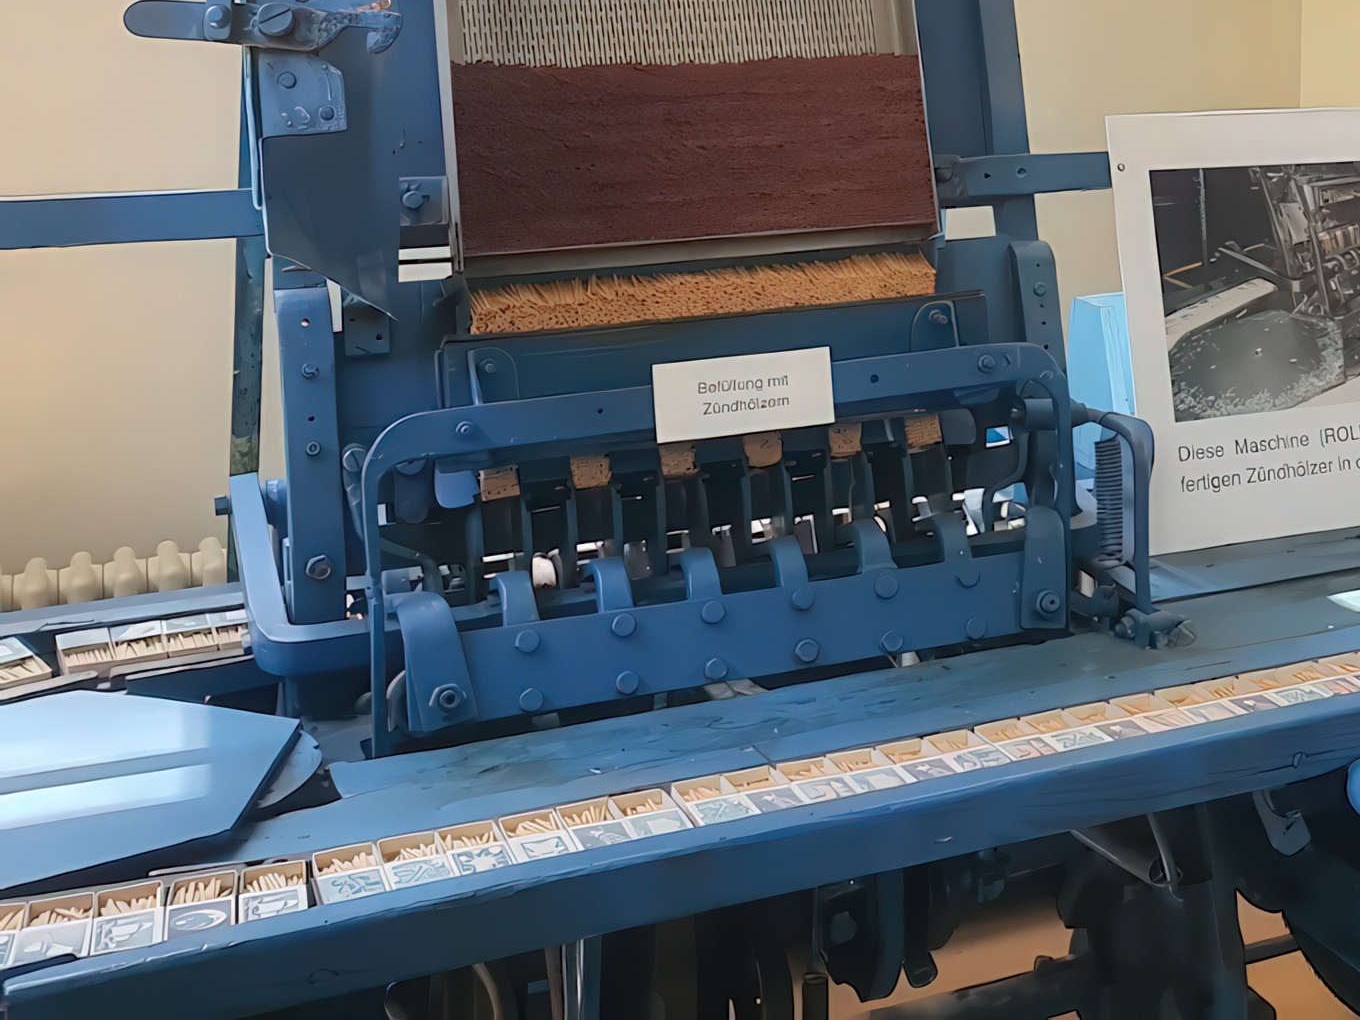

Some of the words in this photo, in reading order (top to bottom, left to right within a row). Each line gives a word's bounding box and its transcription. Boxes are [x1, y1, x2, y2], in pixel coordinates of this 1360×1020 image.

[767, 375, 789, 388] mit
[702, 396, 790, 416] Zündhölzern
[1178, 444, 1225, 462] Diese
[1234, 433, 1310, 455] Maschine
[1180, 473, 1242, 493] fertigen
[1246, 459, 1333, 484] Zündhölzer
[1338, 455, 1351, 472] in
